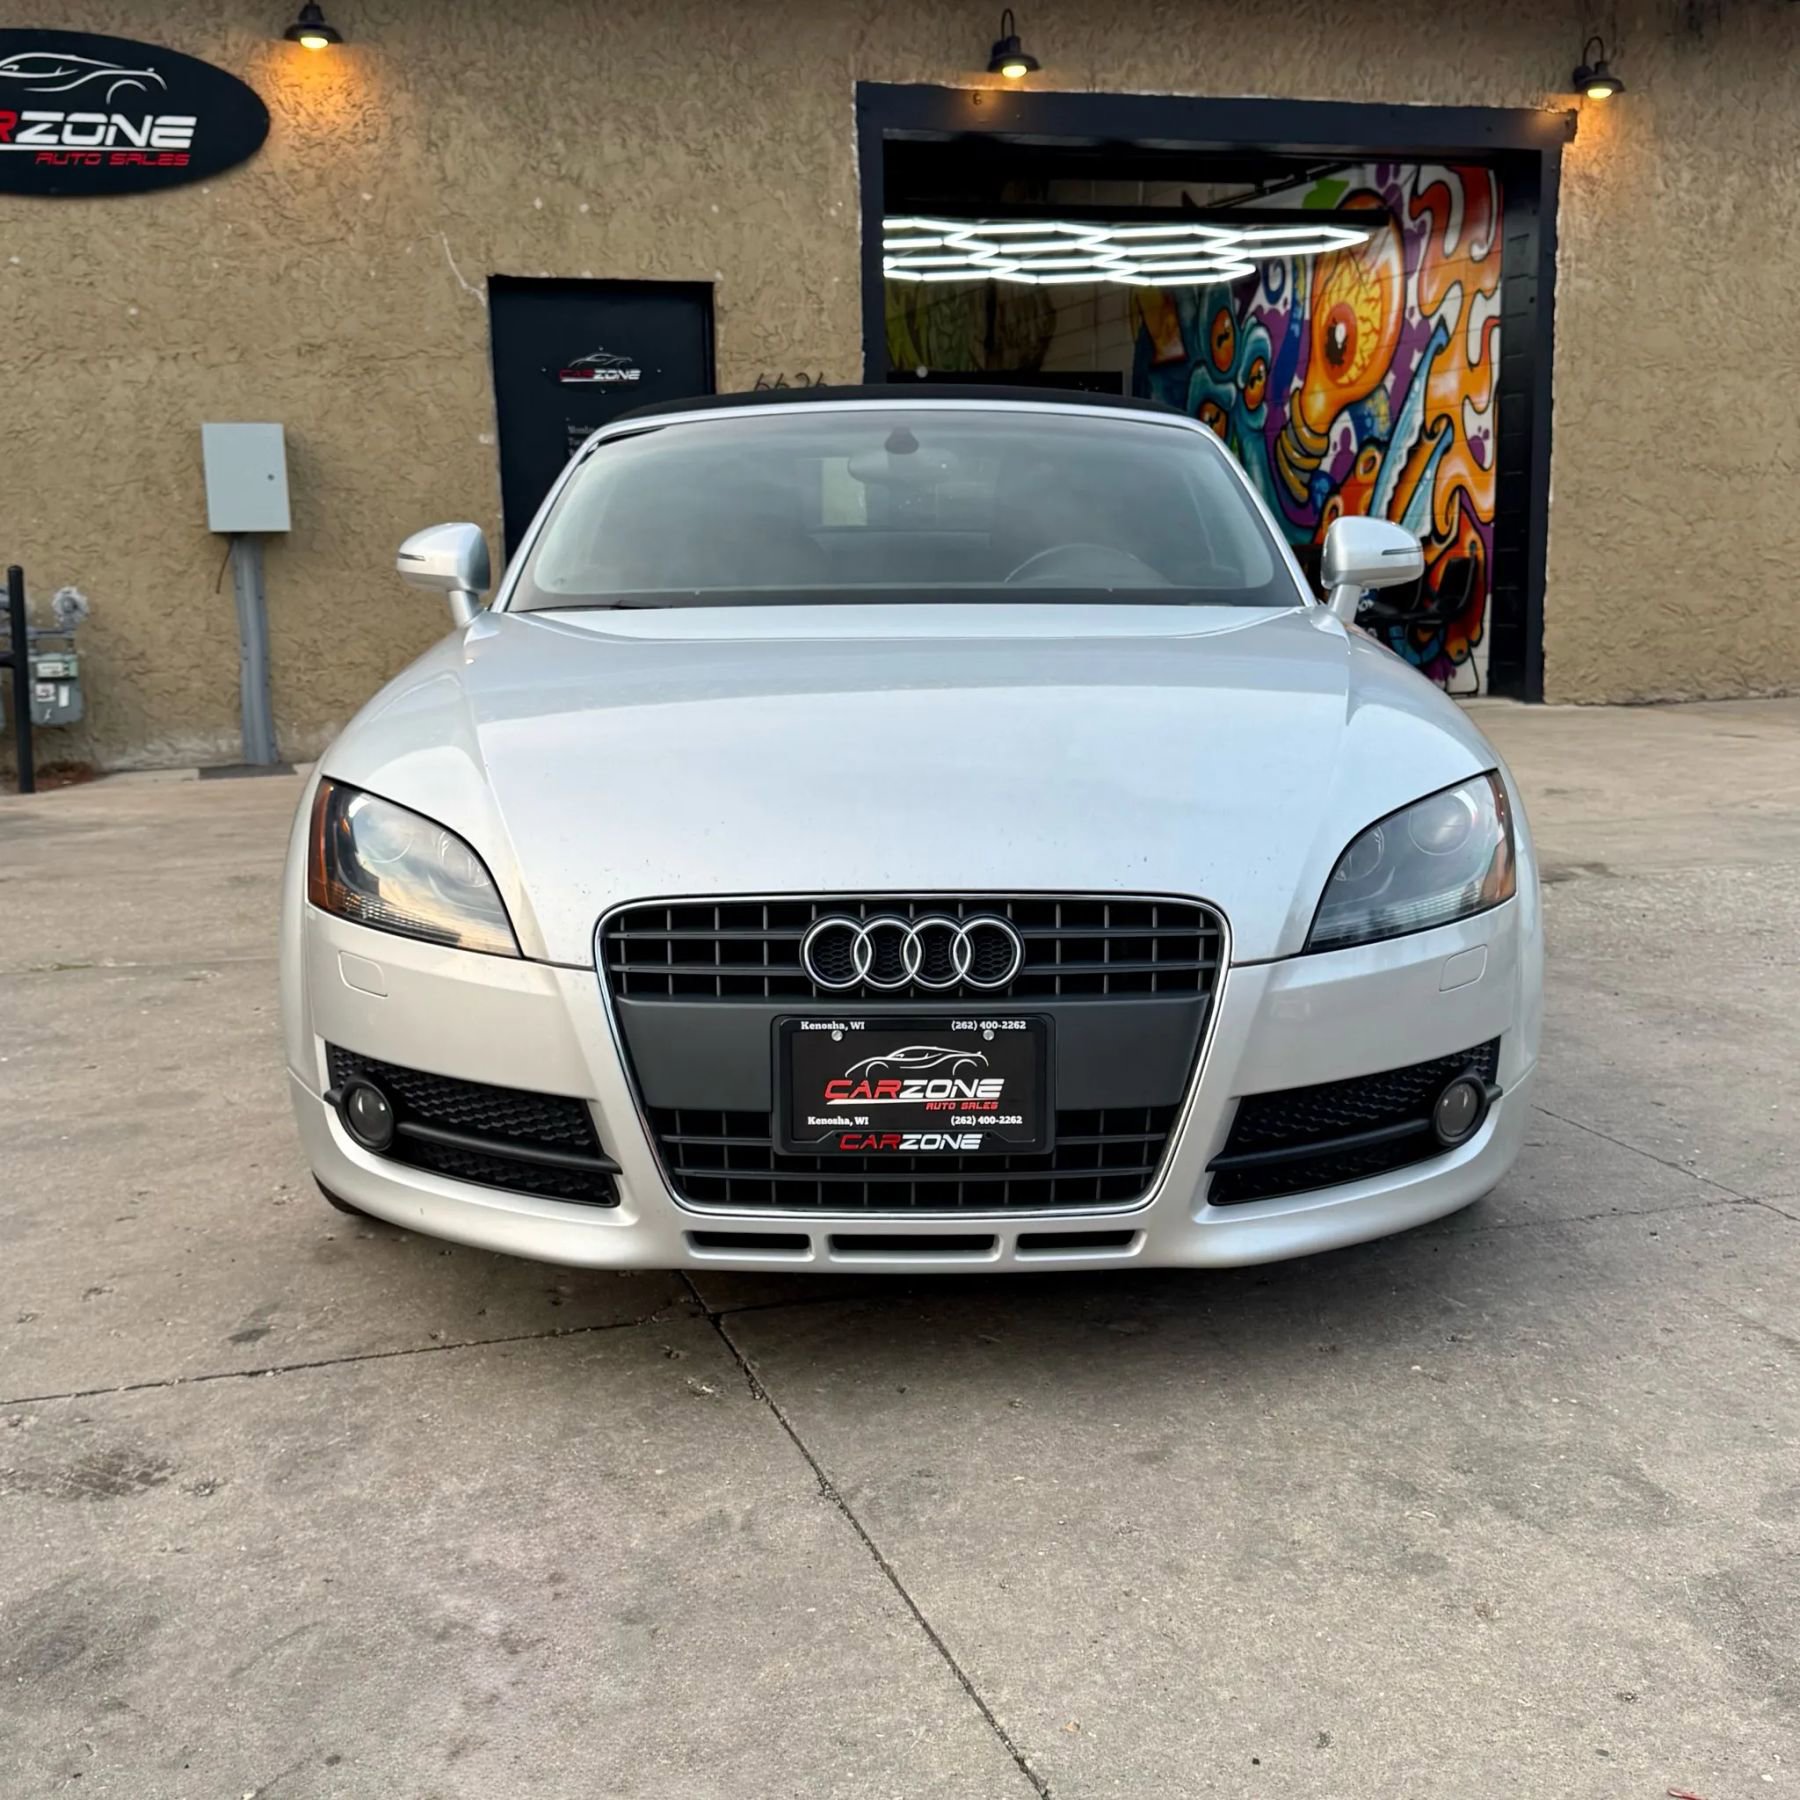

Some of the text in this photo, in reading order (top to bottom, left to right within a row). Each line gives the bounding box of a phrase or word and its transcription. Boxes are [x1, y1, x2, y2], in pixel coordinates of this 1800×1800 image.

[35, 152, 191, 167] AUTO SALES
[800, 1020, 865, 1031] Kenosha, WI
[951, 1019, 1027, 1031] (262) 400-2262
[824, 1078, 1005, 1099] CARZONE
[925, 1101, 999, 1110] AUTO SALES
[807, 1115, 869, 1127] Kenosha, WI
[950, 1114, 1023, 1126] (262) 400-2262
[840, 1133, 983, 1150] CARZONE
